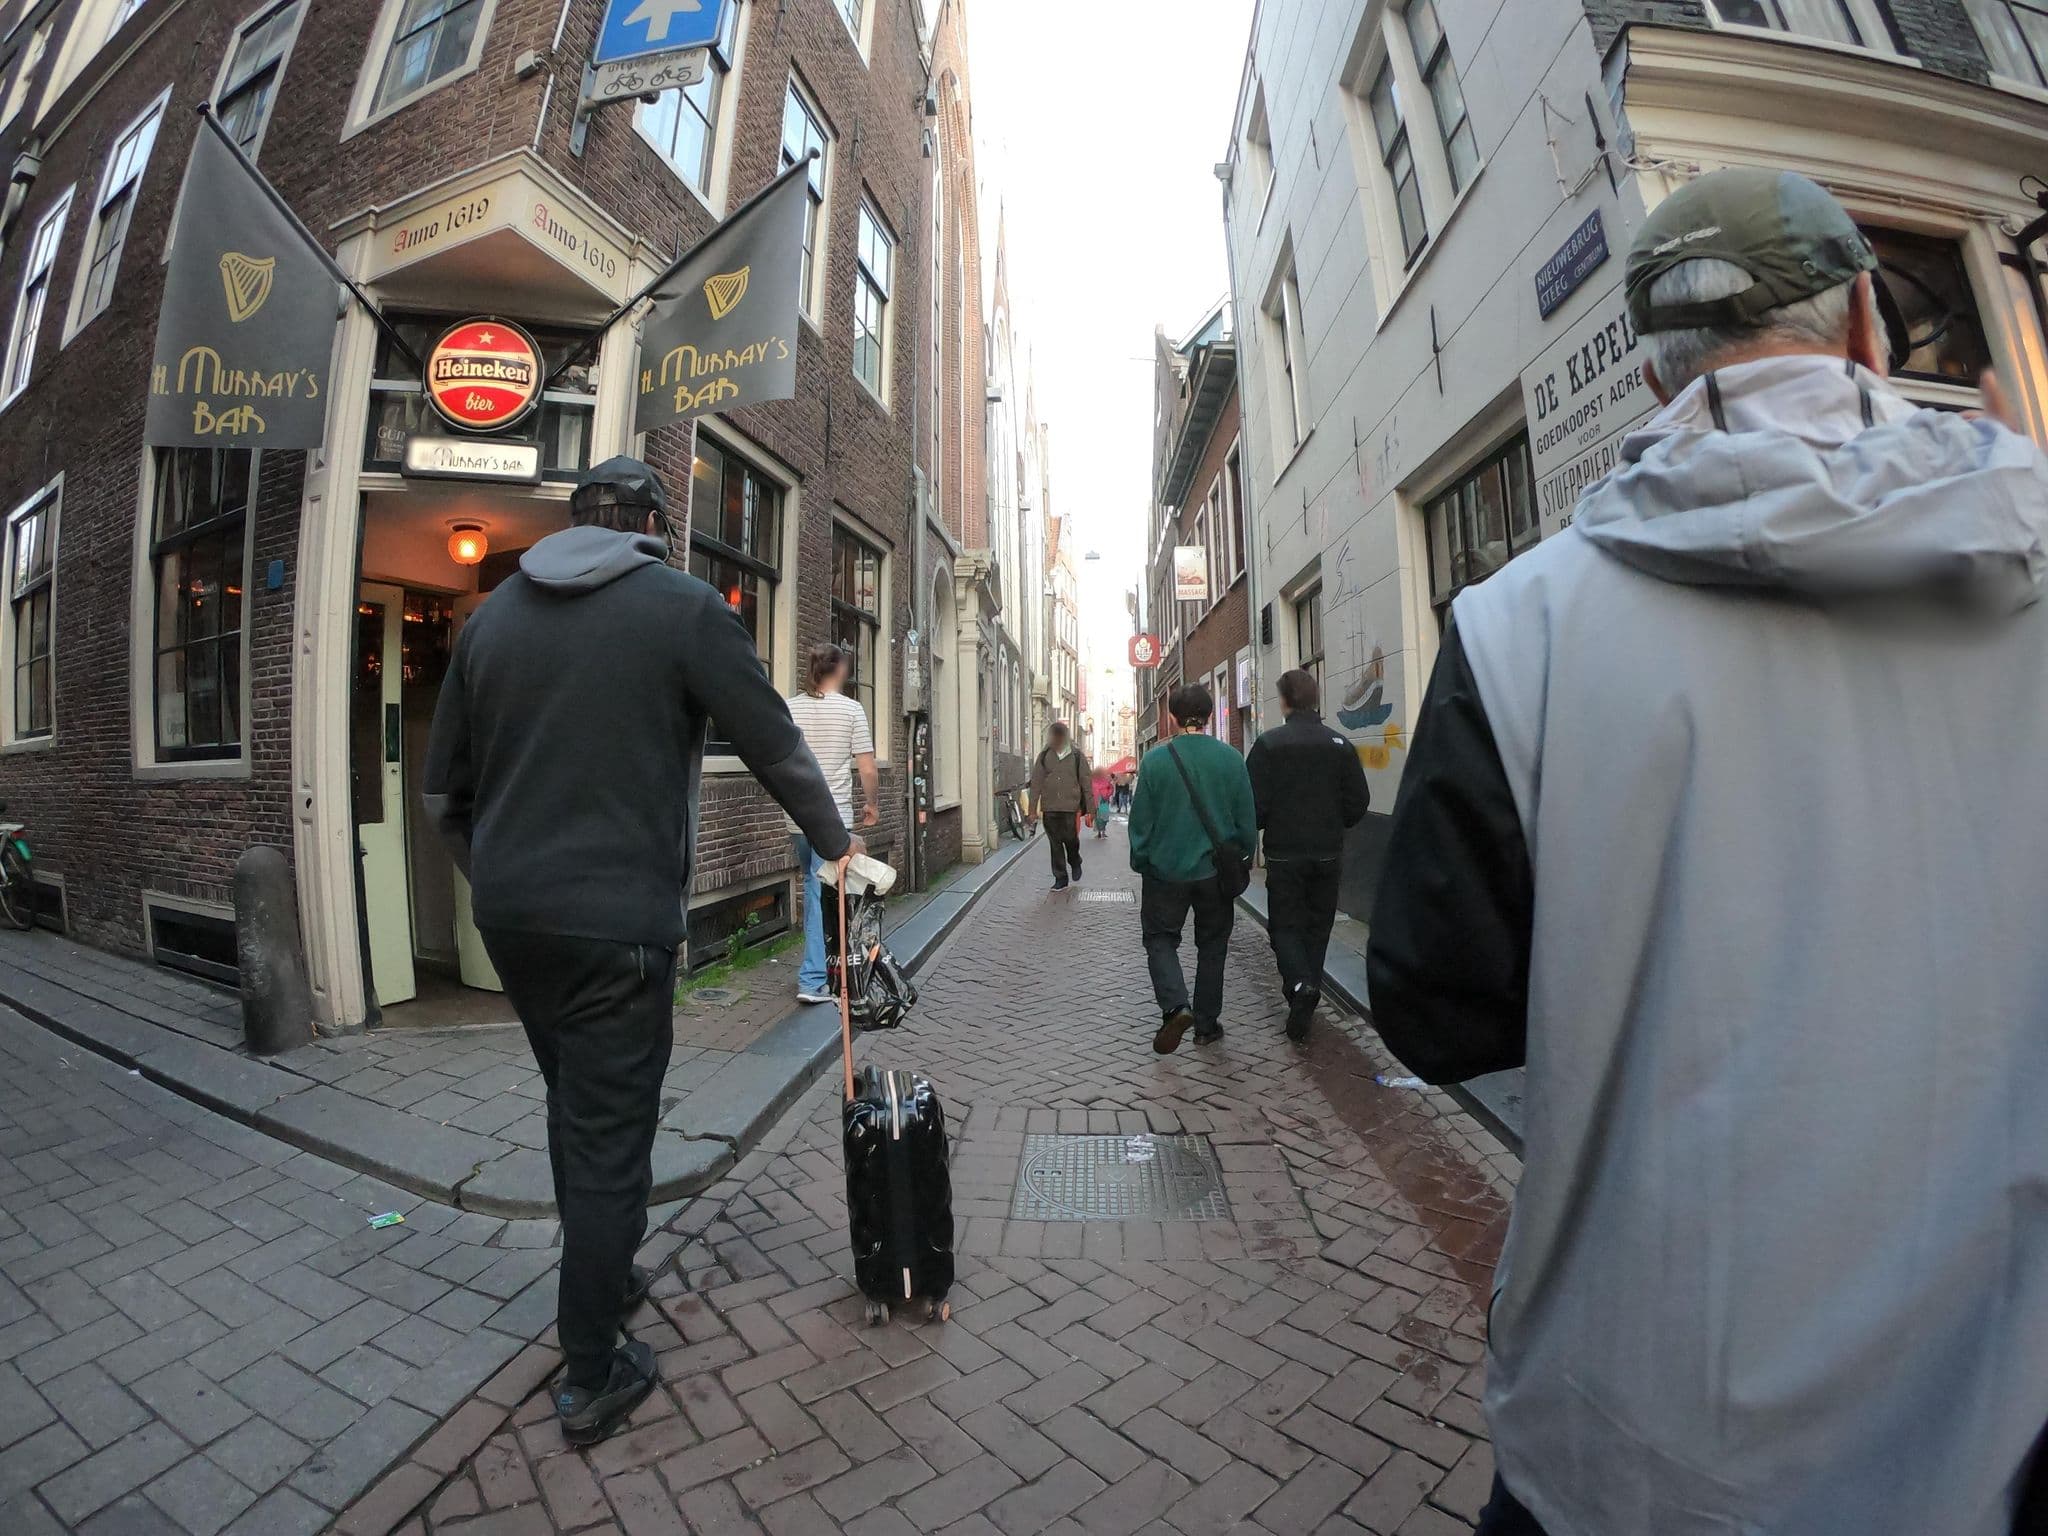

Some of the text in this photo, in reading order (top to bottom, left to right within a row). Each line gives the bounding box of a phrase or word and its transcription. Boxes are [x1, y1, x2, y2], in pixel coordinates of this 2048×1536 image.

[393, 197, 489, 253] Anno 1619
[532, 203, 616, 279] Anno 1619
[1537, 217, 1599, 292] NIEUWEBRUG
[1541, 274, 1568, 312] STEEG
[152, 364, 169, 395] H.
[437, 359, 530, 382] Heineken
[641, 369, 655, 394] H.
[1534, 311, 1638, 422] DE KAPEL
[465, 391, 495, 411] bier
[674, 377, 739, 414] BAR
[1536, 366, 1642, 455] GOEDKOOPST ADRE
[193, 400, 266, 435] BAR
[1577, 424, 1600, 446] VOOR
